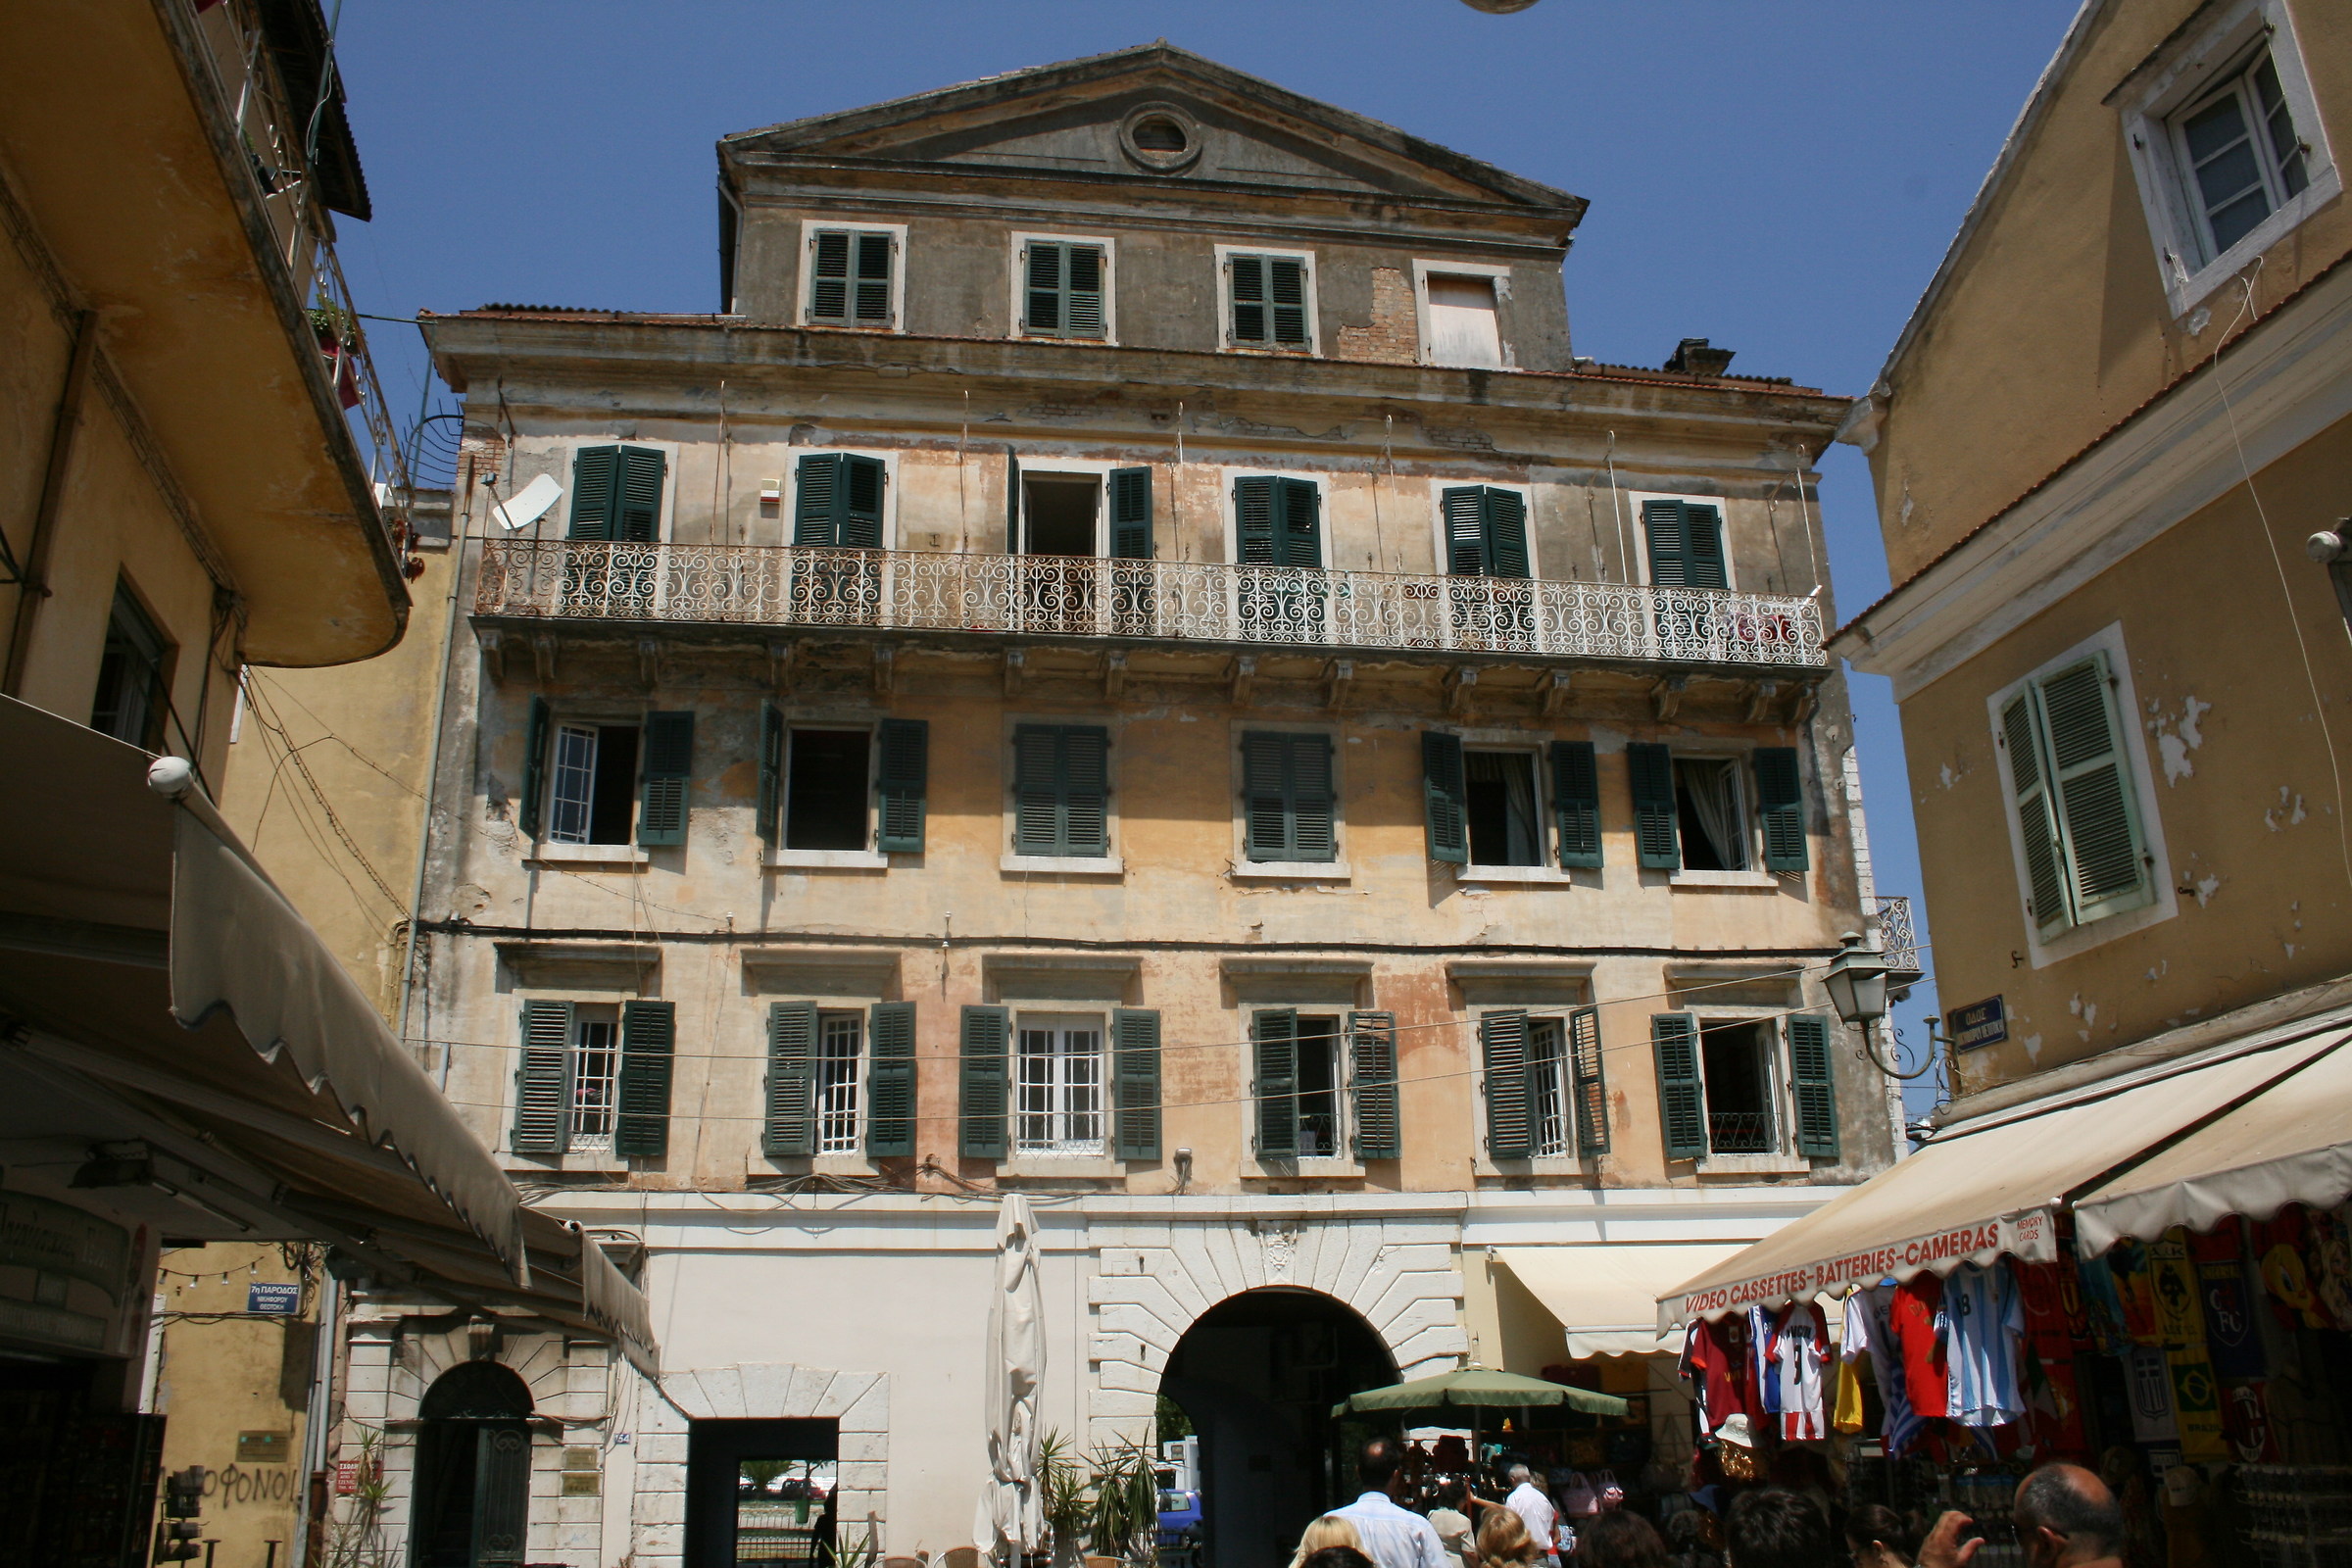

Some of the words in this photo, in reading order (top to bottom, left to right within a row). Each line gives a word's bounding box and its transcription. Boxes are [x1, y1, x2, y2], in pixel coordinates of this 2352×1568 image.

[2017, 1216, 2043, 1230] MEMORY
[2020, 1229, 2038, 1242] CARDS
[251, 1285, 261, 1295] 7η
[261, 1286, 298, 1295] ΠΑΡΟΔΟΣ
[1686, 1289, 1728, 1313] VIDEO
